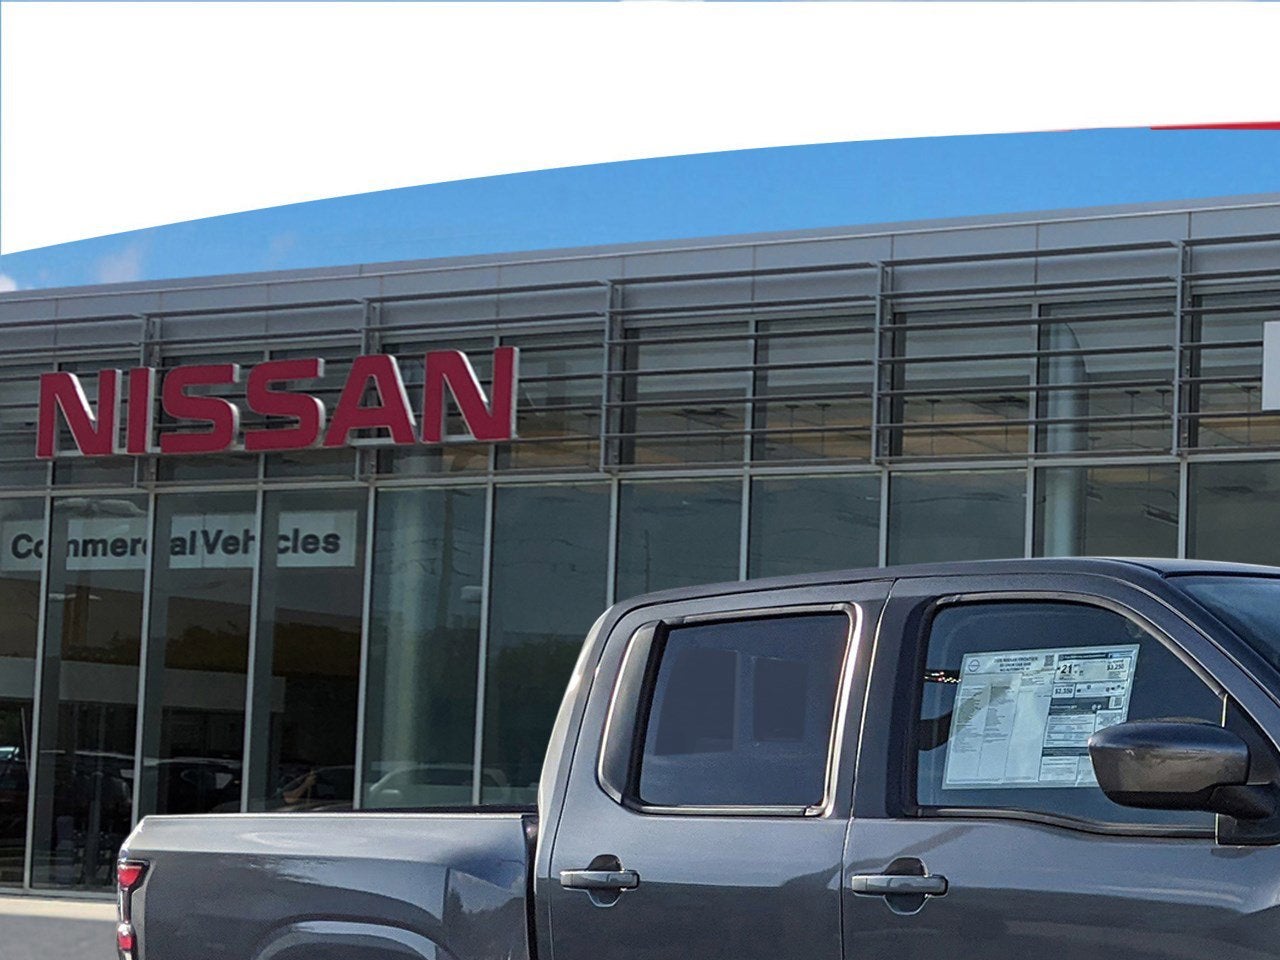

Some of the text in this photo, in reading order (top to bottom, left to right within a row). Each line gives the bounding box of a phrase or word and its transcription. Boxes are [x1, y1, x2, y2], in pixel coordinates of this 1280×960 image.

[36, 346, 519, 459] NISSAN
[11, 528, 341, 560] Cmeral Vehcles
